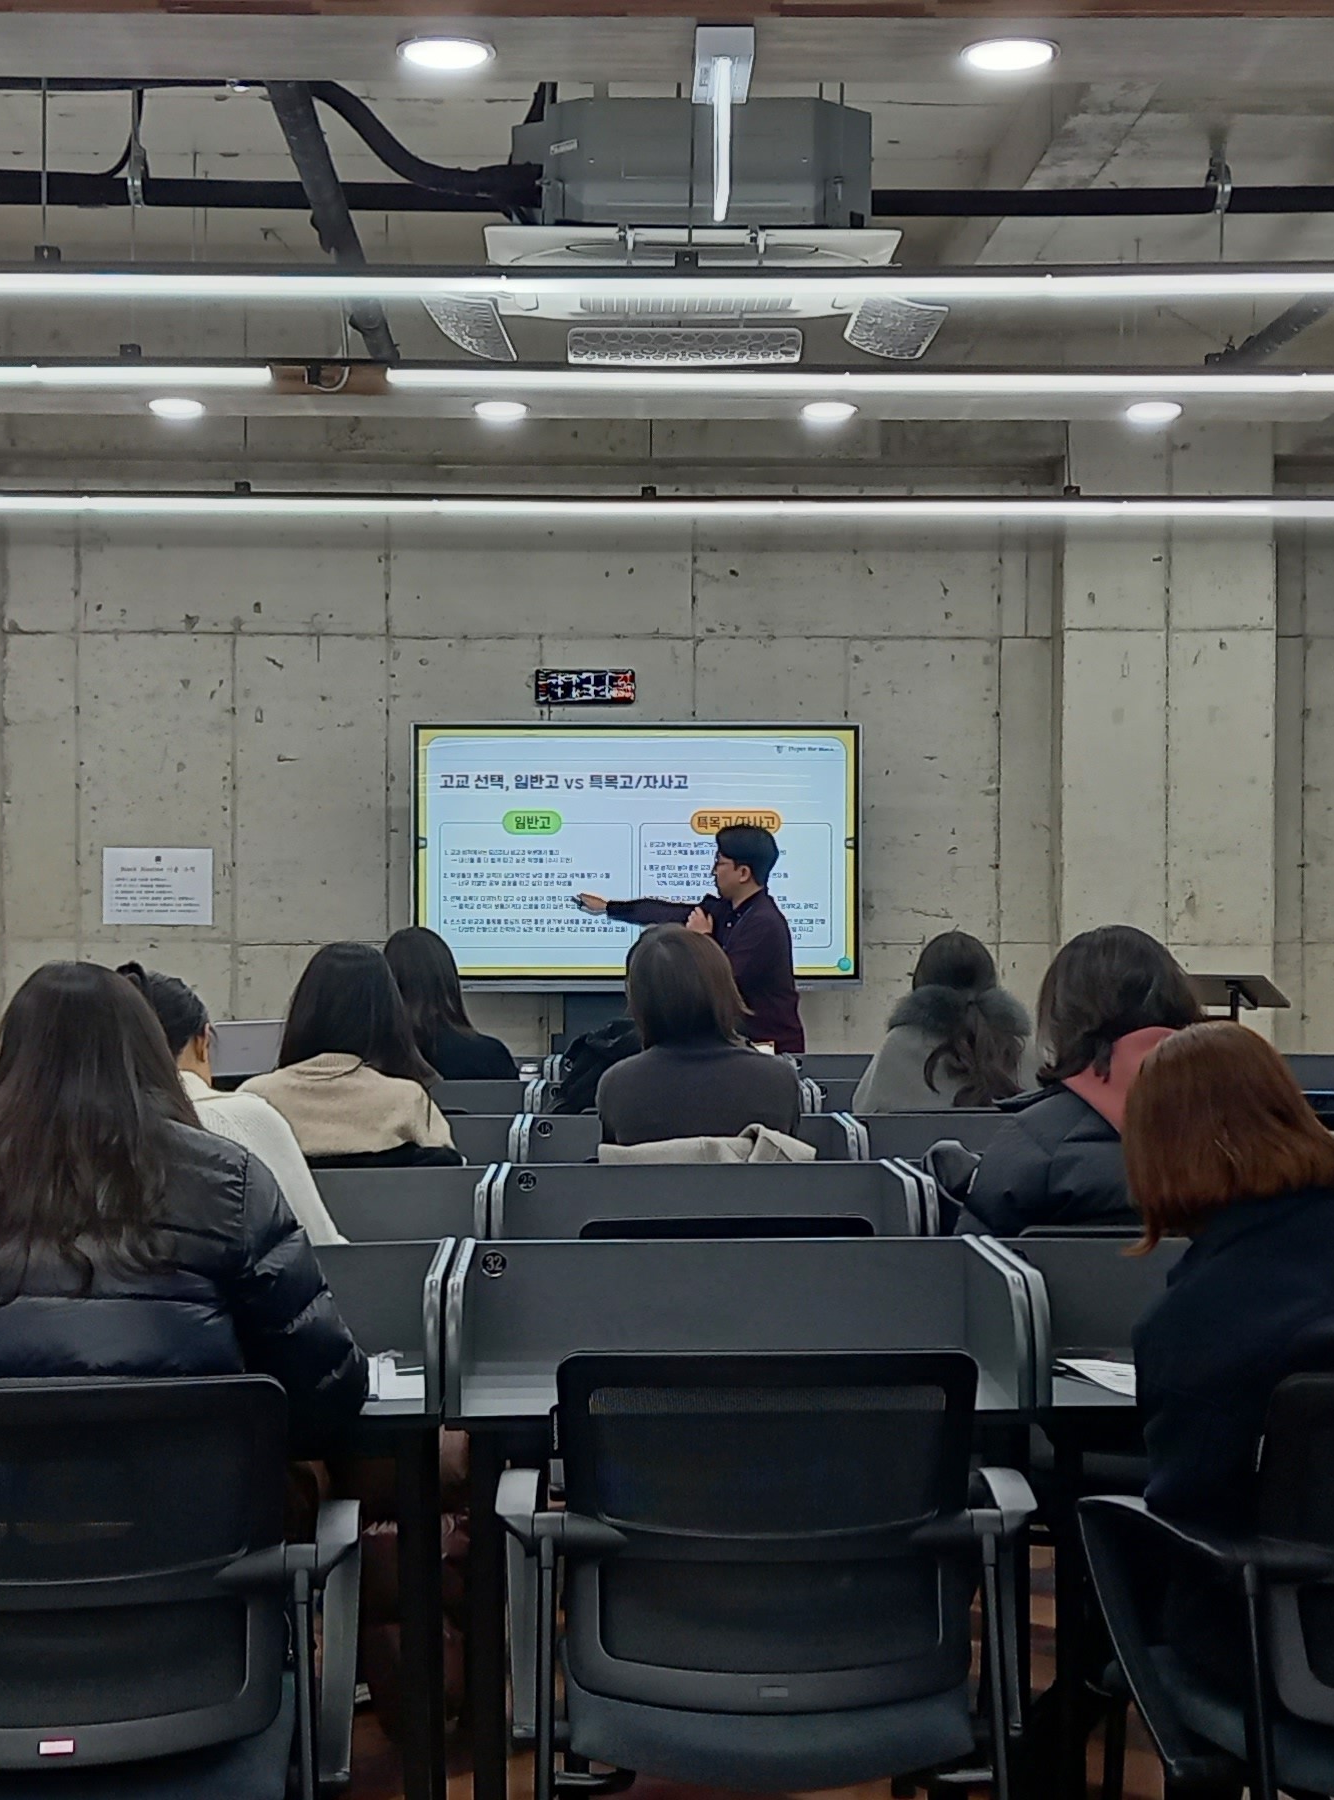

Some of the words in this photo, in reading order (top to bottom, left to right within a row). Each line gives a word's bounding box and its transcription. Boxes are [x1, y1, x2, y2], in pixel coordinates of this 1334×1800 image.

[439, 774, 470, 790] 고교
[474, 774, 510, 792] 선택,
[514, 774, 560, 790] 일반고
[564, 777, 584, 790] vs
[588, 774, 689, 791] 특목고/자사고
[514, 815, 551, 830] 일반고
[521, 1174, 534, 1187] 25
[485, 1255, 503, 1271] 32
